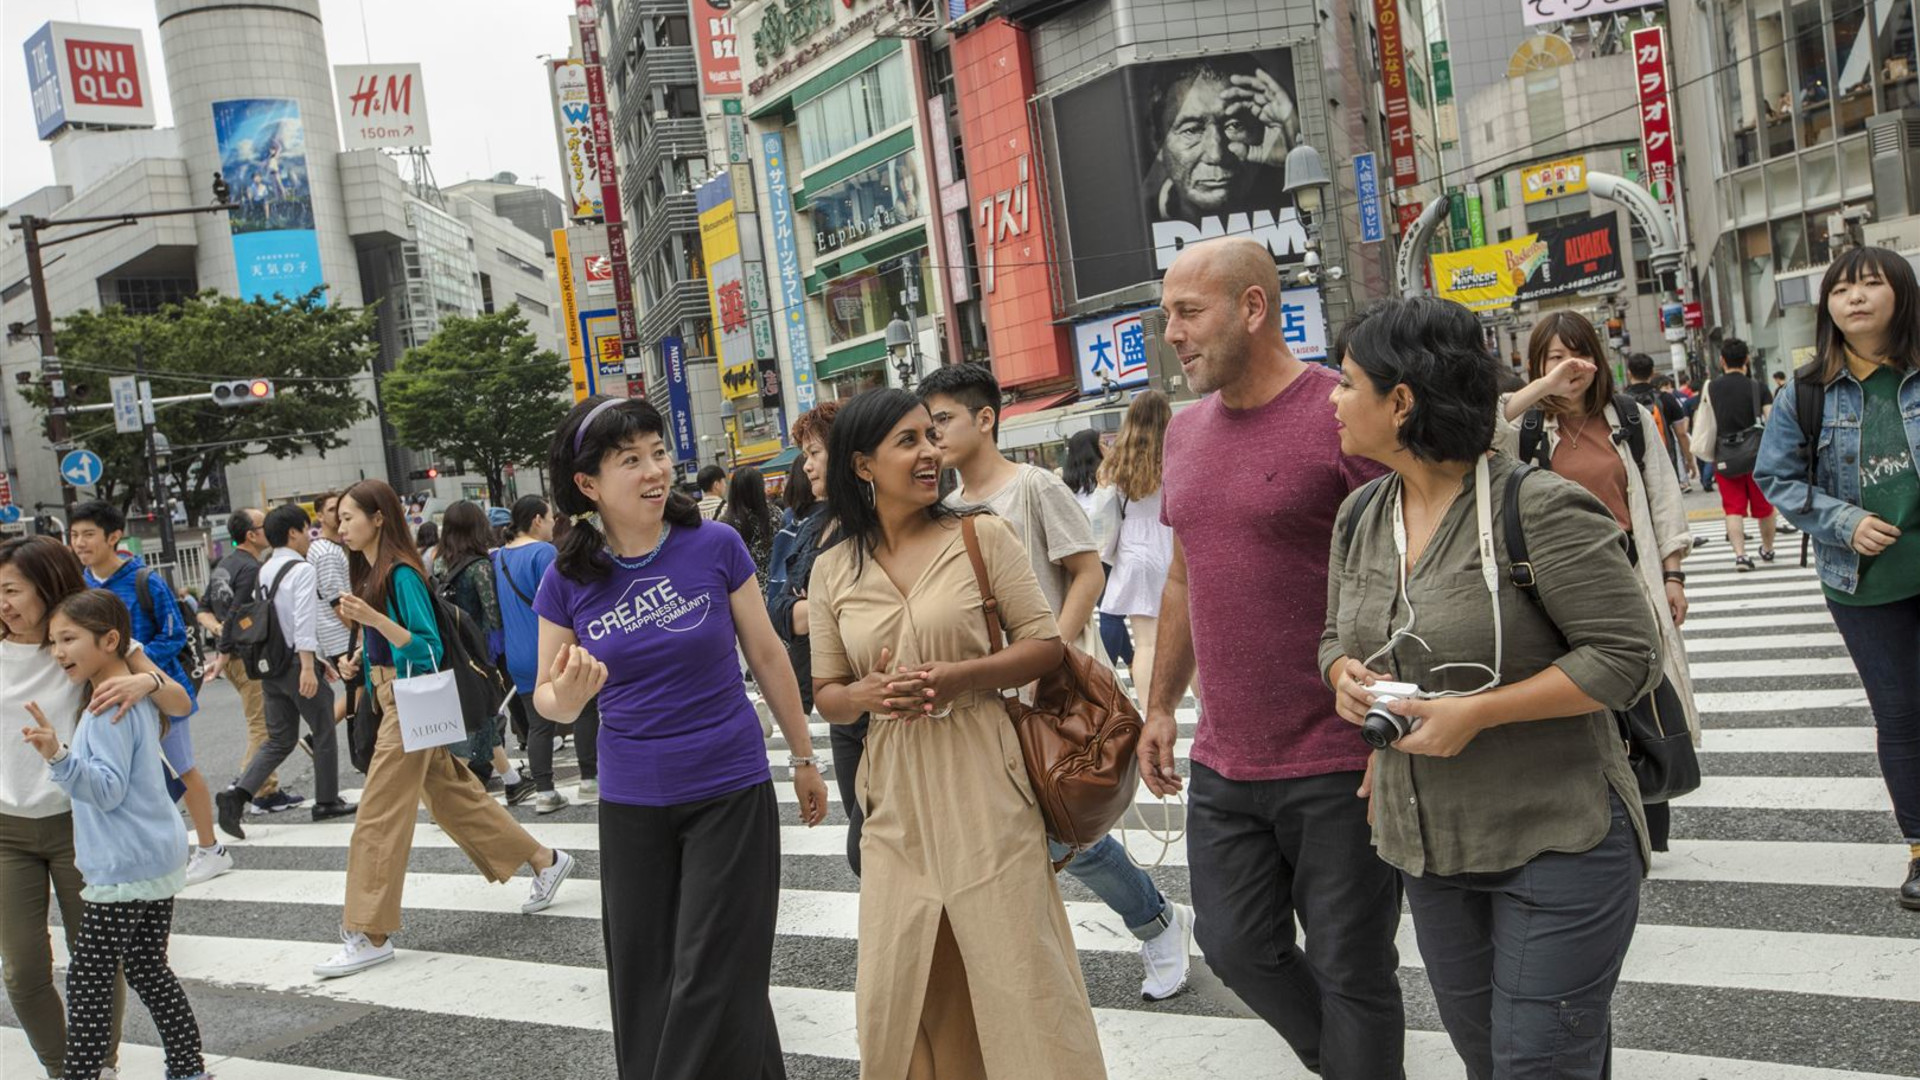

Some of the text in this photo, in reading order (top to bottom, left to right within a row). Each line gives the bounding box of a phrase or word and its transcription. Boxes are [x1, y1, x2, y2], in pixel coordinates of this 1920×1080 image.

[74, 48, 125, 73] UNI
[79, 75, 133, 102] QLO
[349, 73, 412, 117] H&M
[360, 127, 400, 139] 150m
[1388, 98, 1415, 177] 三千里
[769, 167, 799, 309] サマーフルーツギフト
[1281, 304, 1306, 342] 店
[670, 346, 682, 383] MIZUHO
[1089, 325, 1147, 373] 大盛
[587, 578, 678, 640] CREATE
[624, 595, 686, 634] HAPPINESS &
[656, 592, 711, 628] COMMUNITY
[411, 720, 458, 737] ALBION
